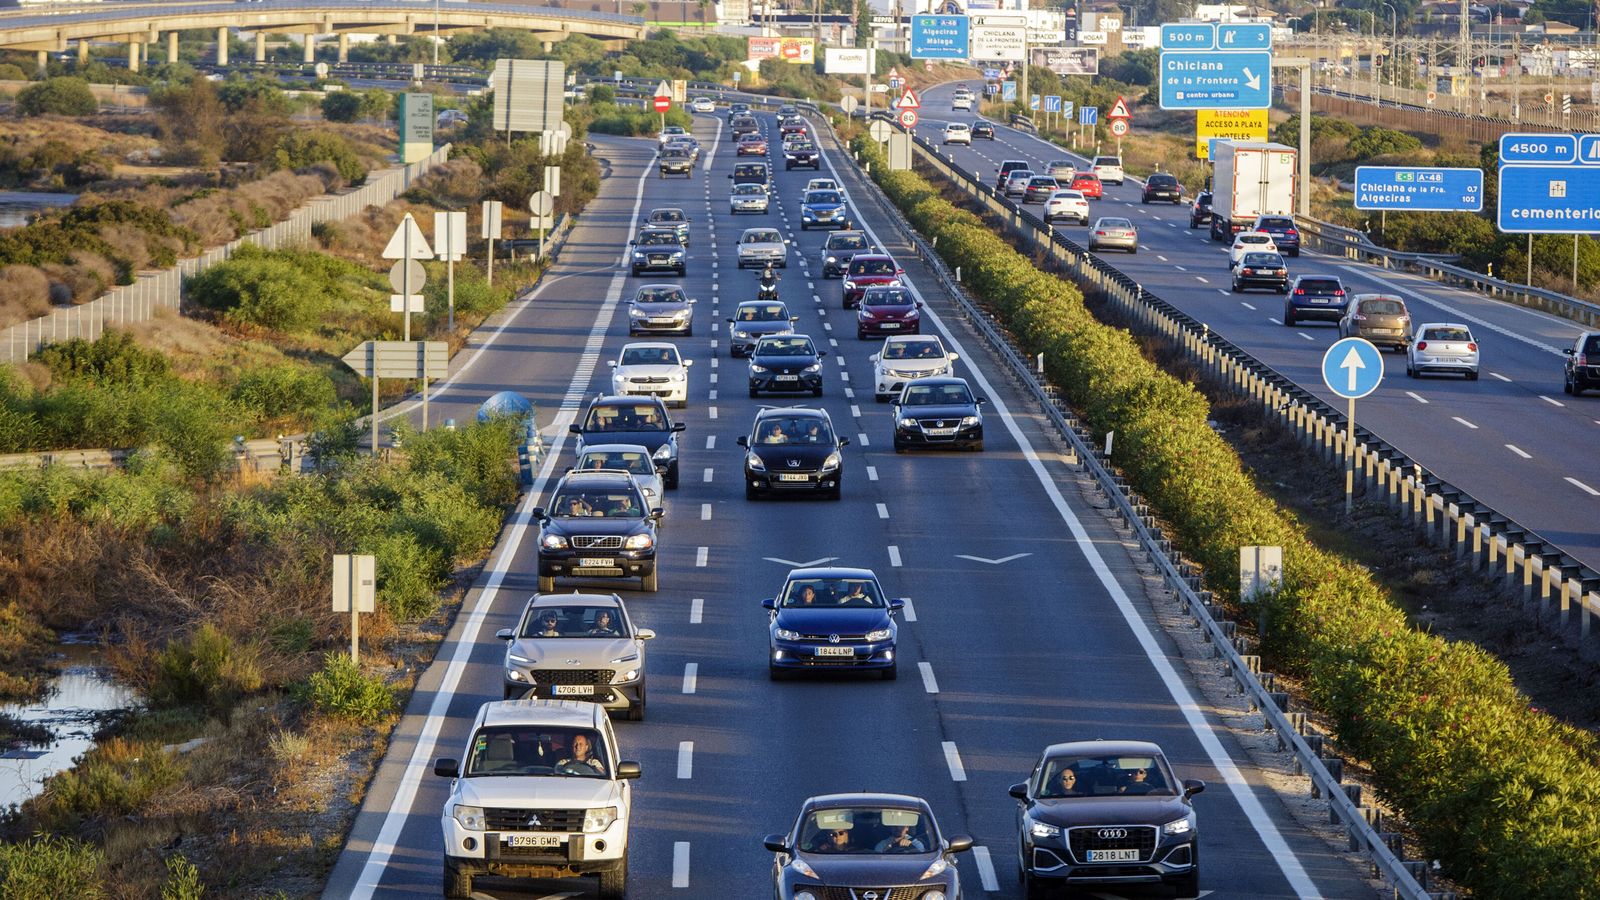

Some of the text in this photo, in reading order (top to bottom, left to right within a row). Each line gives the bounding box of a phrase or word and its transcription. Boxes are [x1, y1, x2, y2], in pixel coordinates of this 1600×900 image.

[922, 28, 958, 36] Algeciras
[1169, 33, 1205, 42] 500 m
[1258, 33, 1265, 42] 3
[1168, 61, 1224, 71] Chiclana
[1168, 77, 1239, 85] de la Frontera
[903, 114, 914, 122] 80
[1114, 124, 1125, 132] 80
[1240, 121, 1263, 129] PLAYA
[1219, 132, 1251, 140] HOTELES
[1509, 144, 1567, 154] 4500 m
[1397, 173, 1442, 181] E-5 A-48
[1360, 183, 1406, 193] Chiclana
[1360, 194, 1411, 203] Algeciras
[557, 686, 593, 694] 4706 LVH
[514, 837, 558, 846] 9796 GMR
[1092, 851, 1136, 860] 2818 LNT
